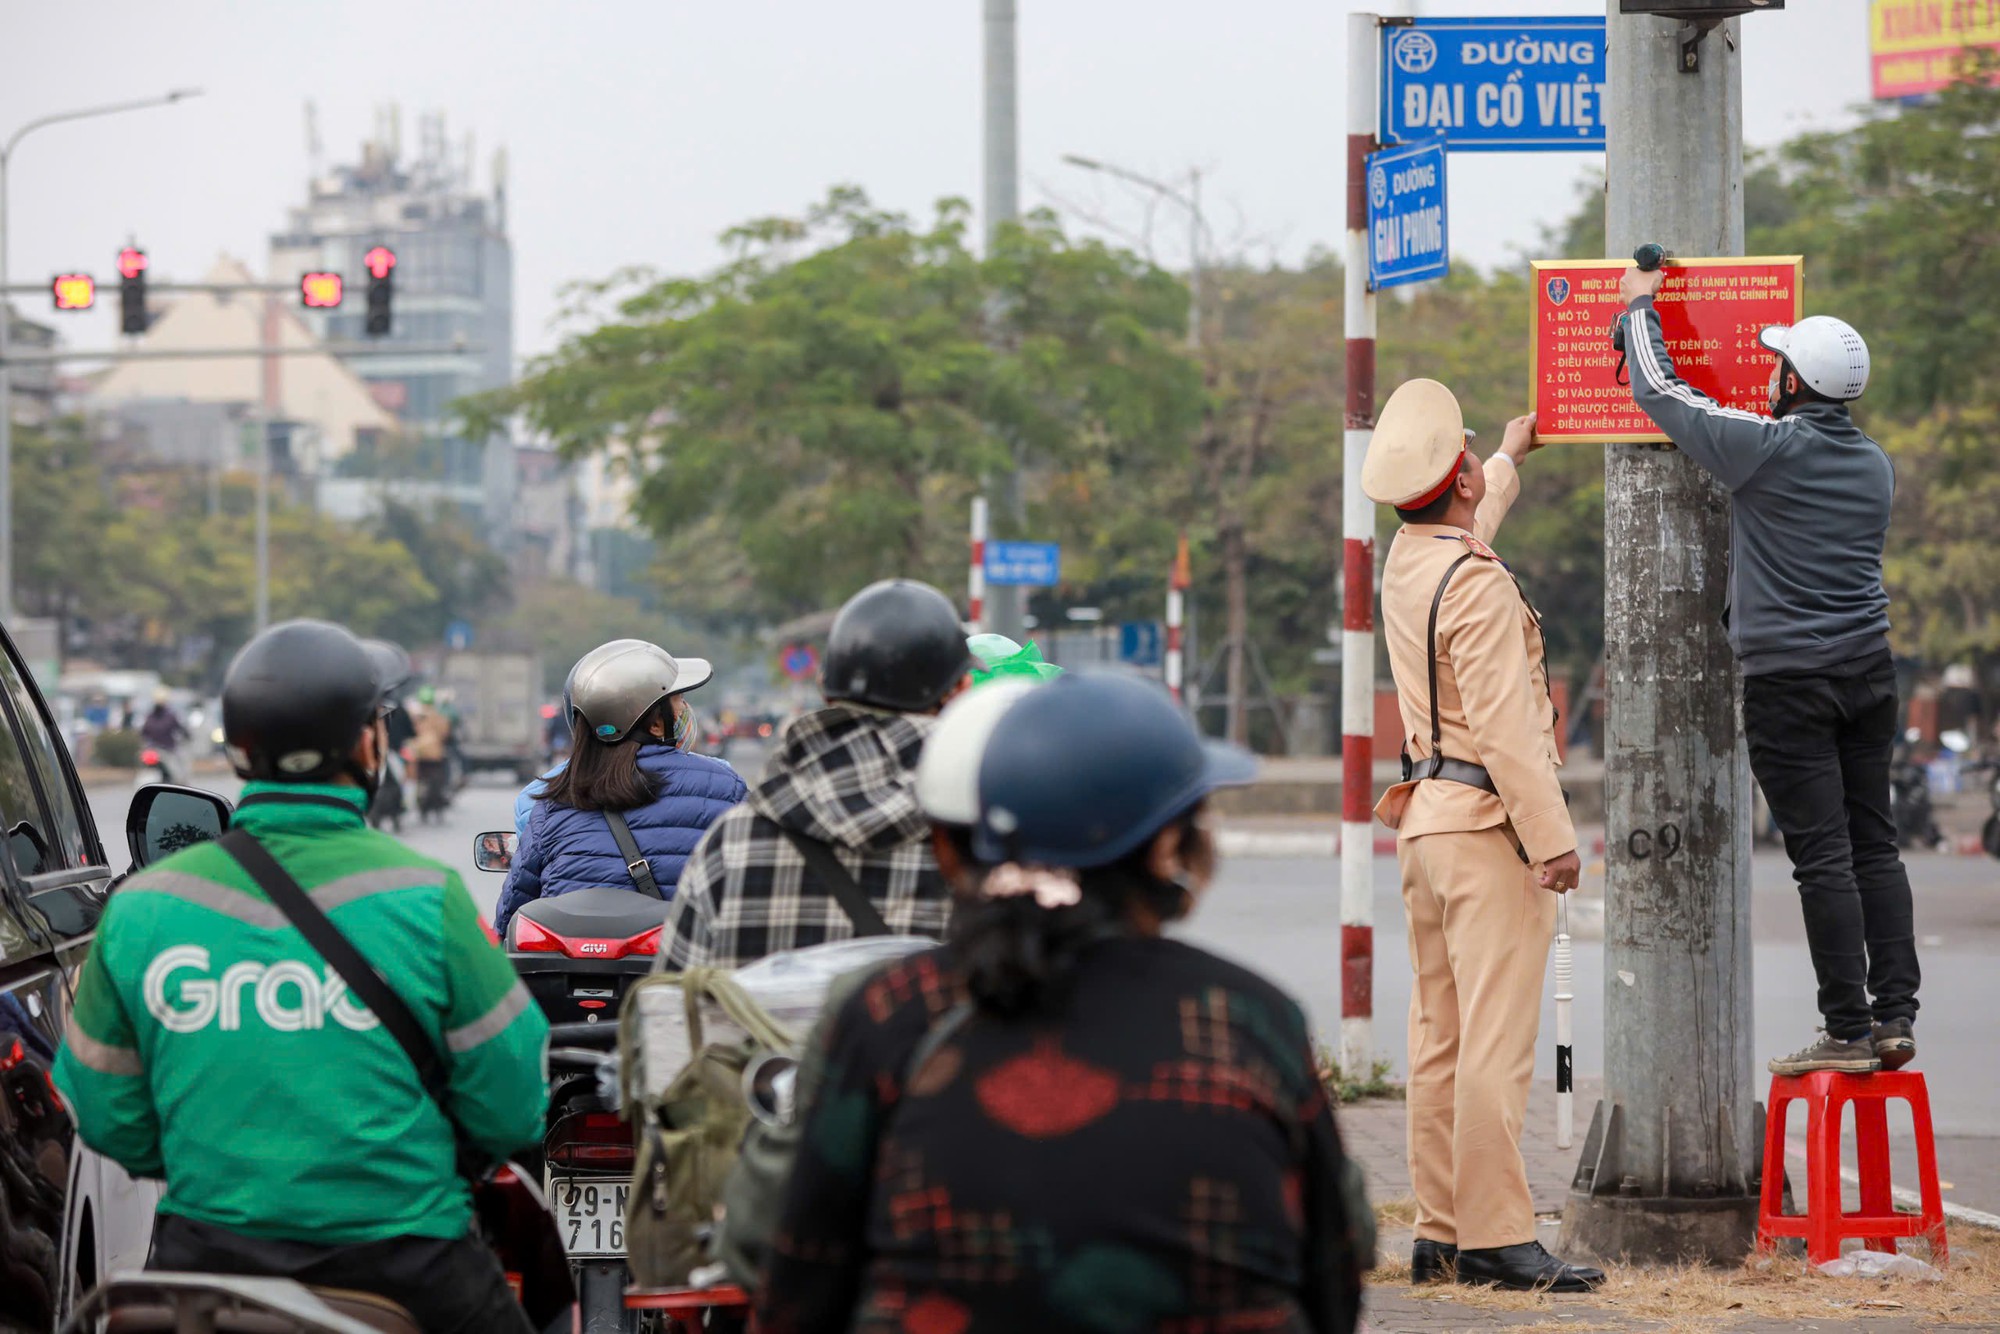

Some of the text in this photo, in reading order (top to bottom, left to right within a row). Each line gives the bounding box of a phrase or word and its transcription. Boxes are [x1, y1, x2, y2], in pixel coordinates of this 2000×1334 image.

[1461, 33, 1595, 65] ĐƯỜNG
[1403, 83, 1465, 135] ĐẠI
[1476, 69, 1524, 128] CỒ
[1392, 160, 1436, 196] ĐƯỜNG
[1375, 196, 1442, 263] GIẢI PHÓNG
[1581, 275, 1778, 290] MỨC XỬ MỘT SỐ HÀNH VI VI PHẠM
[1573, 293, 1596, 304] THEO
[1655, 291, 1717, 302] 8/2024/NĐ-CP
[1719, 288, 1738, 301] CỦA
[1740, 287, 1769, 300] CHÍNH
[1770, 286, 1789, 300] PHỦ
[1547, 309, 1590, 322] 1. MÔ TÔ
[1557, 327, 1568, 337] ĐI
[1571, 325, 1593, 337] VÀO
[1735, 323, 1742, 334] 2
[1751, 323, 1757, 334] 3
[1557, 342, 1568, 352] ĐI
[1571, 341, 1609, 354] NGƯỢC
[1680, 337, 1701, 350] ĐÈN
[1703, 337, 1722, 350] ĐỎ:
[1735, 339, 1742, 349] 4
[1751, 339, 1757, 349] 6
[1557, 353, 1582, 368] ĐIỀU
[1584, 352, 1616, 367] KHIỂN
[1695, 352, 1713, 366] HÈ:
[1736, 355, 1742, 365] 4
[1751, 354, 1757, 365] 6
[1546, 371, 1582, 383] 2. Ô TÔ
[1557, 388, 1568, 398] ĐI
[1571, 387, 1593, 398] VÀO
[1594, 386, 1633, 398] ĐƯỜNG
[1731, 386, 1737, 396] 4
[1751, 385, 1757, 396] 6
[1557, 404, 1568, 413] ĐI
[1571, 403, 1609, 415] NGƯỢC
[1745, 401, 1757, 411] 20
[1557, 416, 1582, 429] ĐIỀU
[1584, 415, 1616, 428] KHIỂN
[1618, 418, 1631, 428] XE
[1633, 418, 1644, 428] ĐI
[1628, 823, 1680, 860] C9
